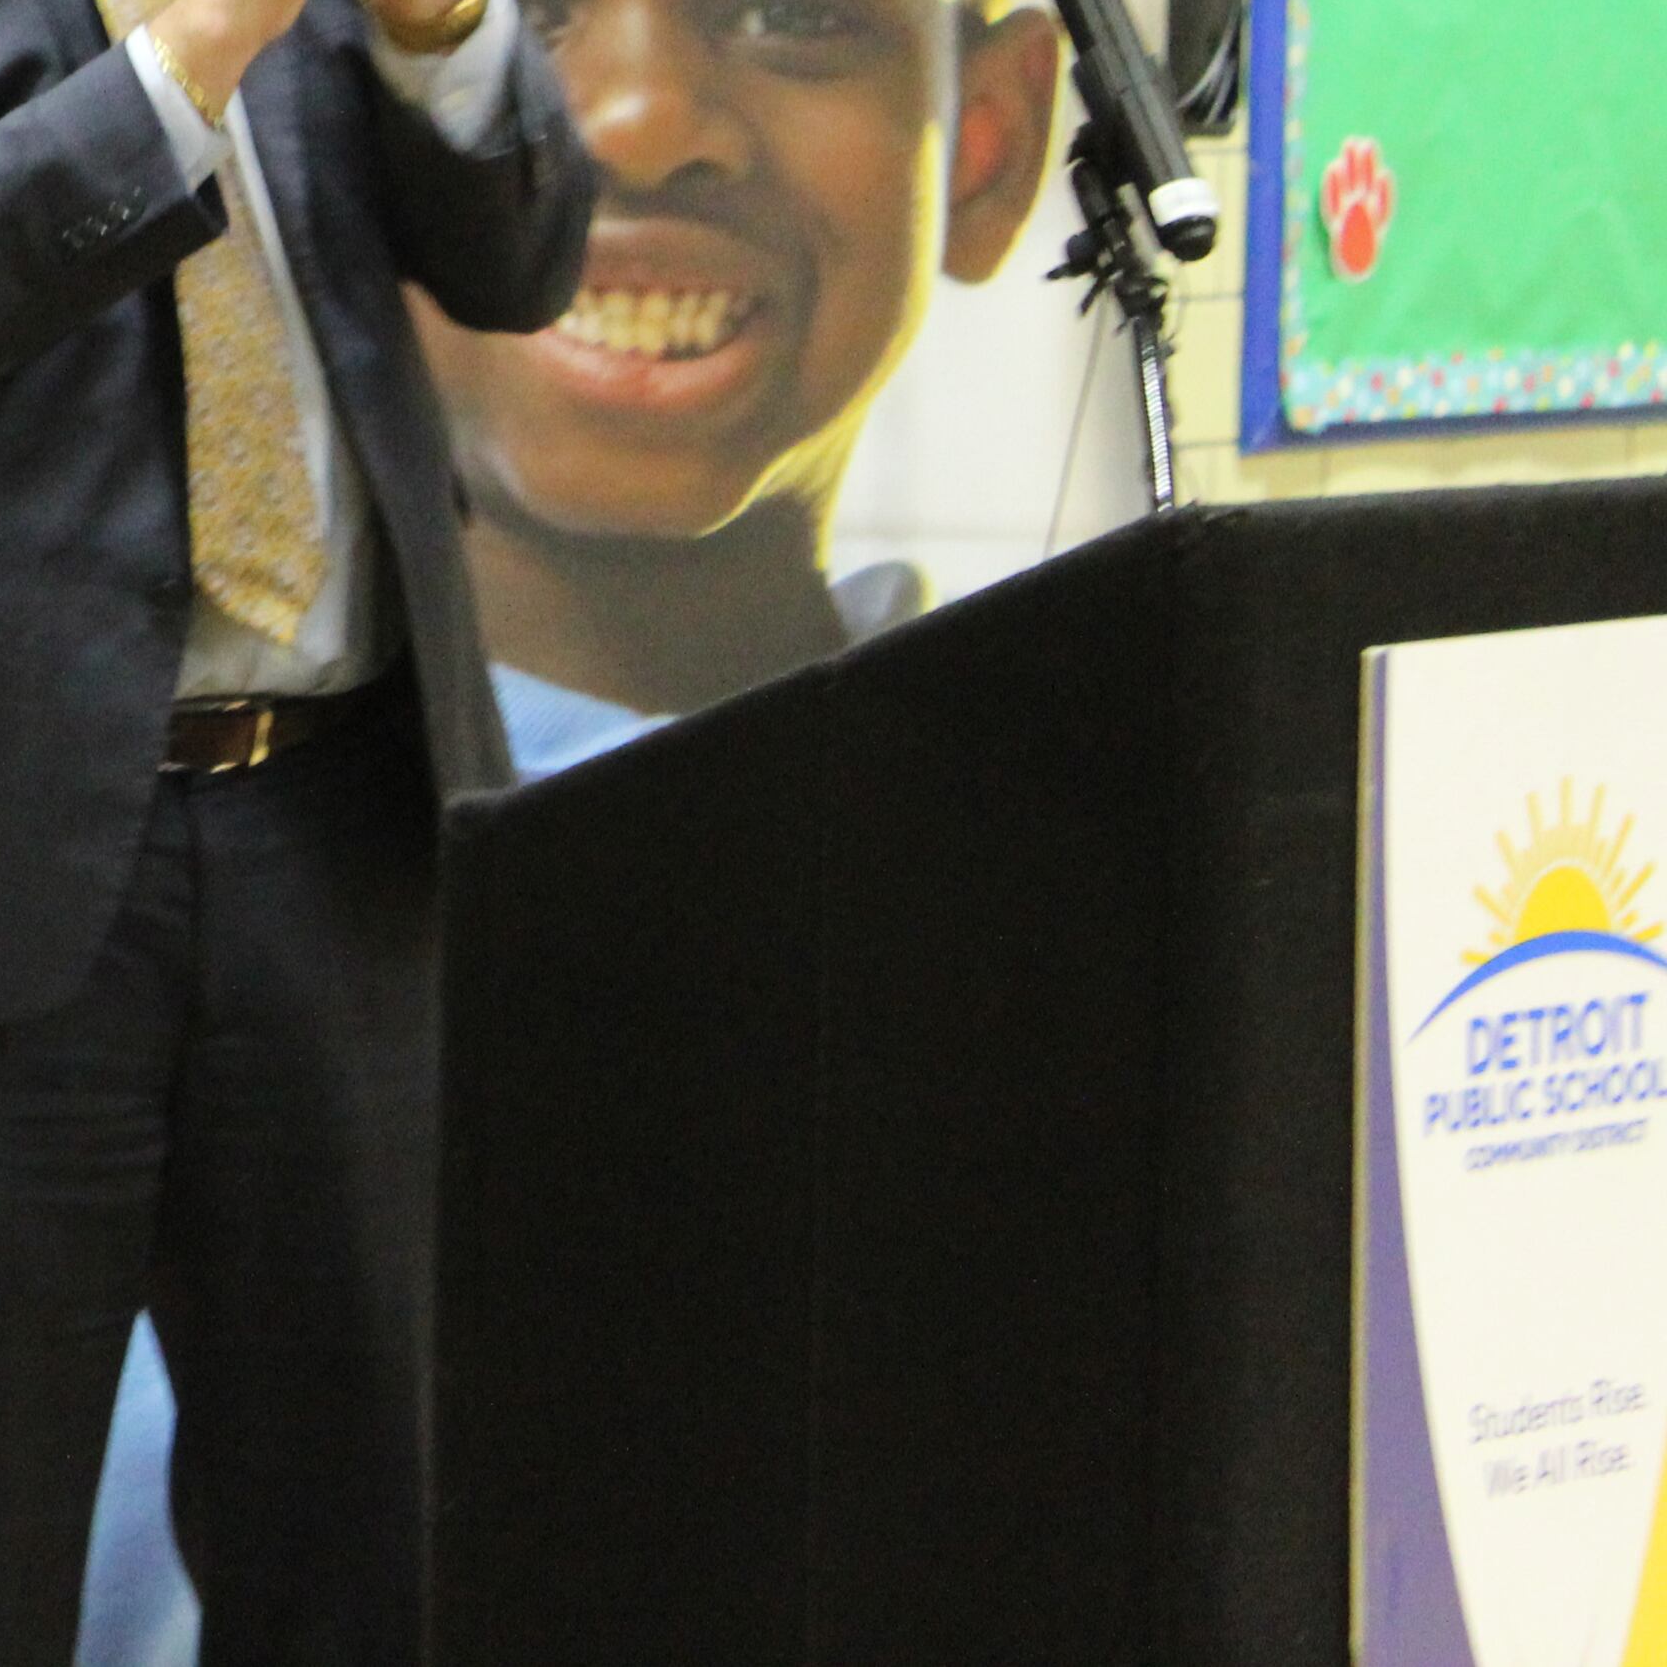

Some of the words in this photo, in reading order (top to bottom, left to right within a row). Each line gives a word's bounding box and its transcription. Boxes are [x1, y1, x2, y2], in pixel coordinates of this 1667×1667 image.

[1465, 992, 1649, 1076] DETROIT
[1423, 1078, 1534, 1140] PUBLIC
[1469, 1394, 1585, 1443] Students
[1483, 1458, 1530, 1499] We
[1532, 1447, 1567, 1488] All
